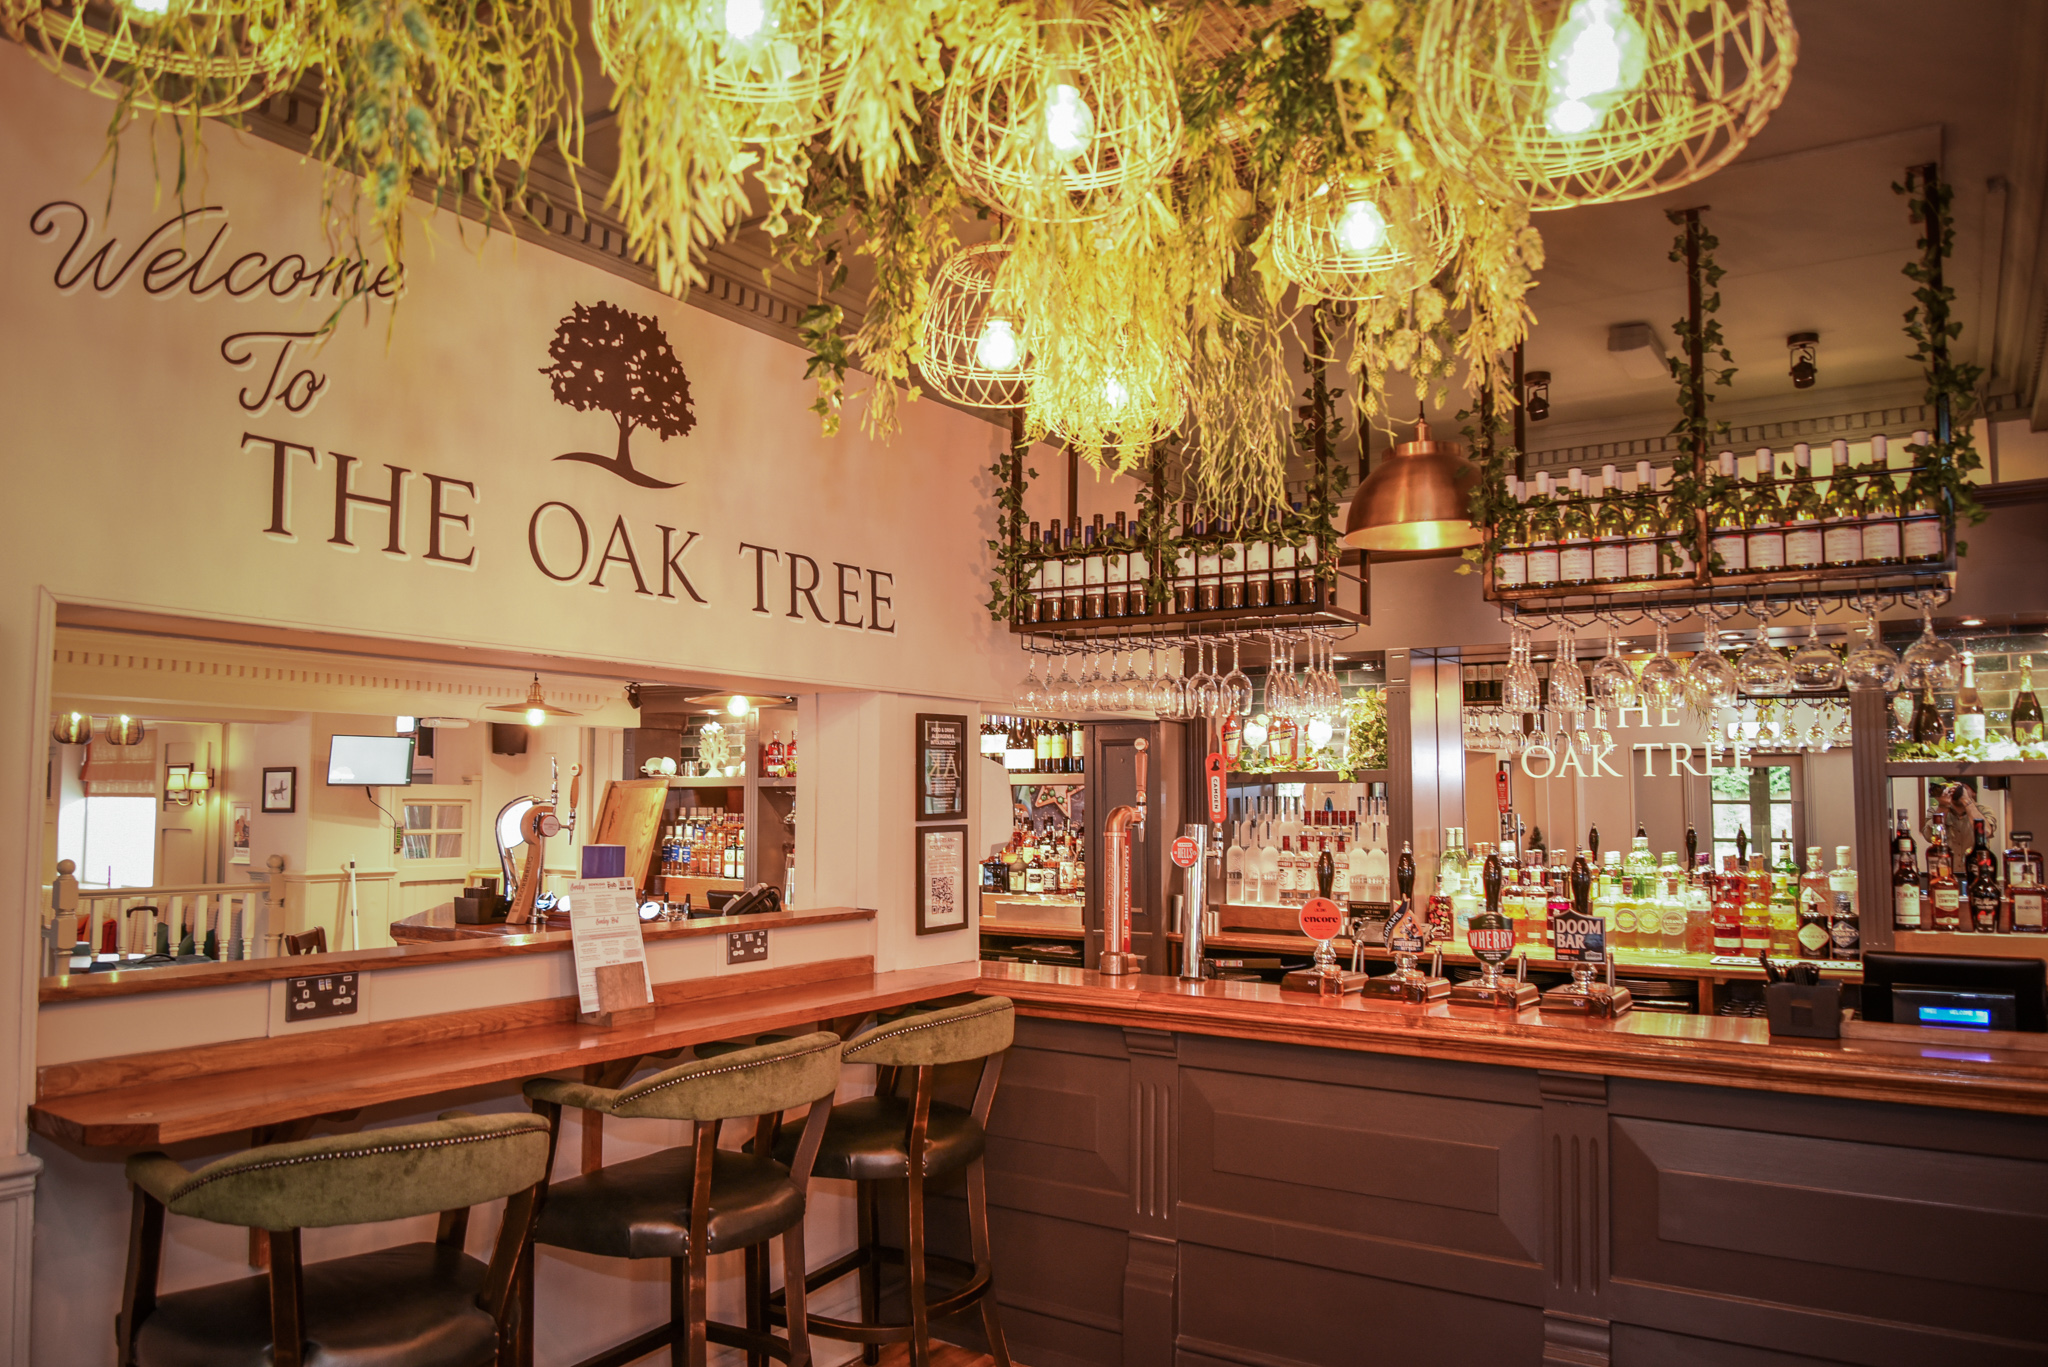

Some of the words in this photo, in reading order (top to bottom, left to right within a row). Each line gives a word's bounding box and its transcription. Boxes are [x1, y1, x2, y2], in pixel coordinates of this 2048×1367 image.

[29, 200, 407, 298] Welcome
[221, 330, 330, 412] To
[241, 431, 476, 567] THE
[528, 501, 708, 604] OAK
[739, 541, 897, 634] TREE
[1521, 742, 1624, 779] OAK
[1633, 741, 1755, 777] TREE
[1177, 847, 1193, 859] HELLS
[1469, 930, 1513, 949] WHERRY
[1555, 918, 1602, 935] DOOM
[1556, 933, 1587, 950] BAR
